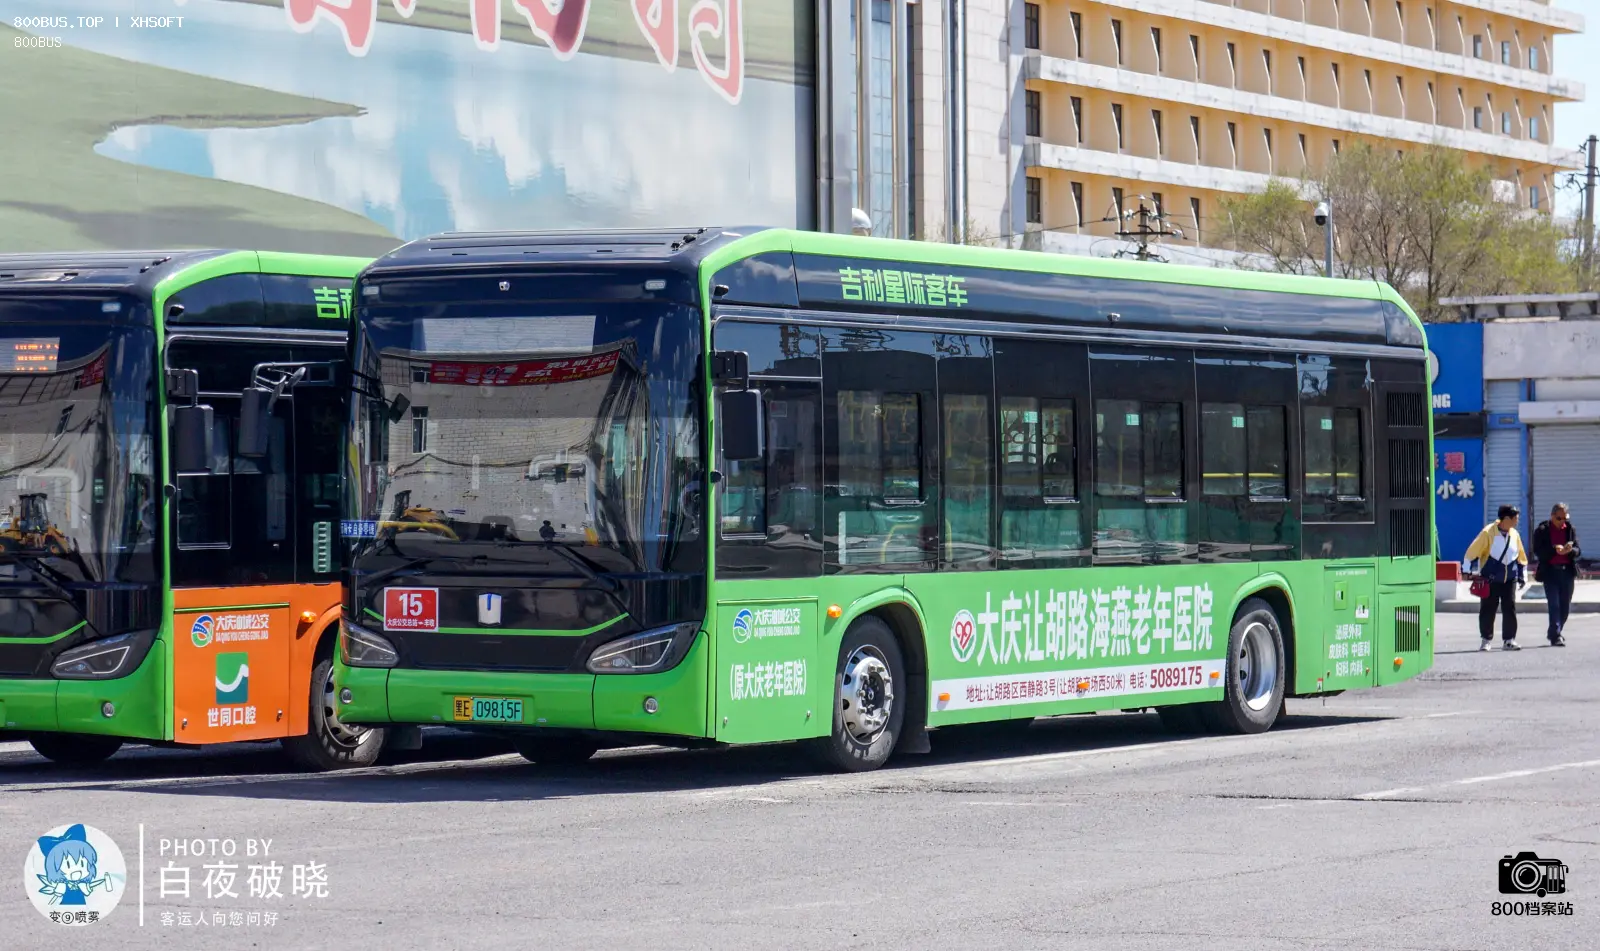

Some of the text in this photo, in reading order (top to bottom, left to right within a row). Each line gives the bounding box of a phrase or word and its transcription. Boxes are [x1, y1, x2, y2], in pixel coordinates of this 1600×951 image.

[838, 266, 969, 307] 吉利星际客车
[1436, 479, 1475, 499] 小米
[399, 593, 423, 616] 15
[216, 614, 269, 631] 大庆油城公交
[976, 581, 1213, 666] 大庆让胡路海燕老年医院
[1335, 624, 1362, 640] 泌尿外科
[1328, 641, 1371, 660] 皮肤科 中医科
[1149, 665, 1203, 689] 5089175
[1335, 660, 1363, 677] 妇科 内科
[730, 659, 807, 701] (原大庆老年医院)
[207, 706, 257, 728] 世同口腔
[455, 700, 522, 719] 黑E 09815F
